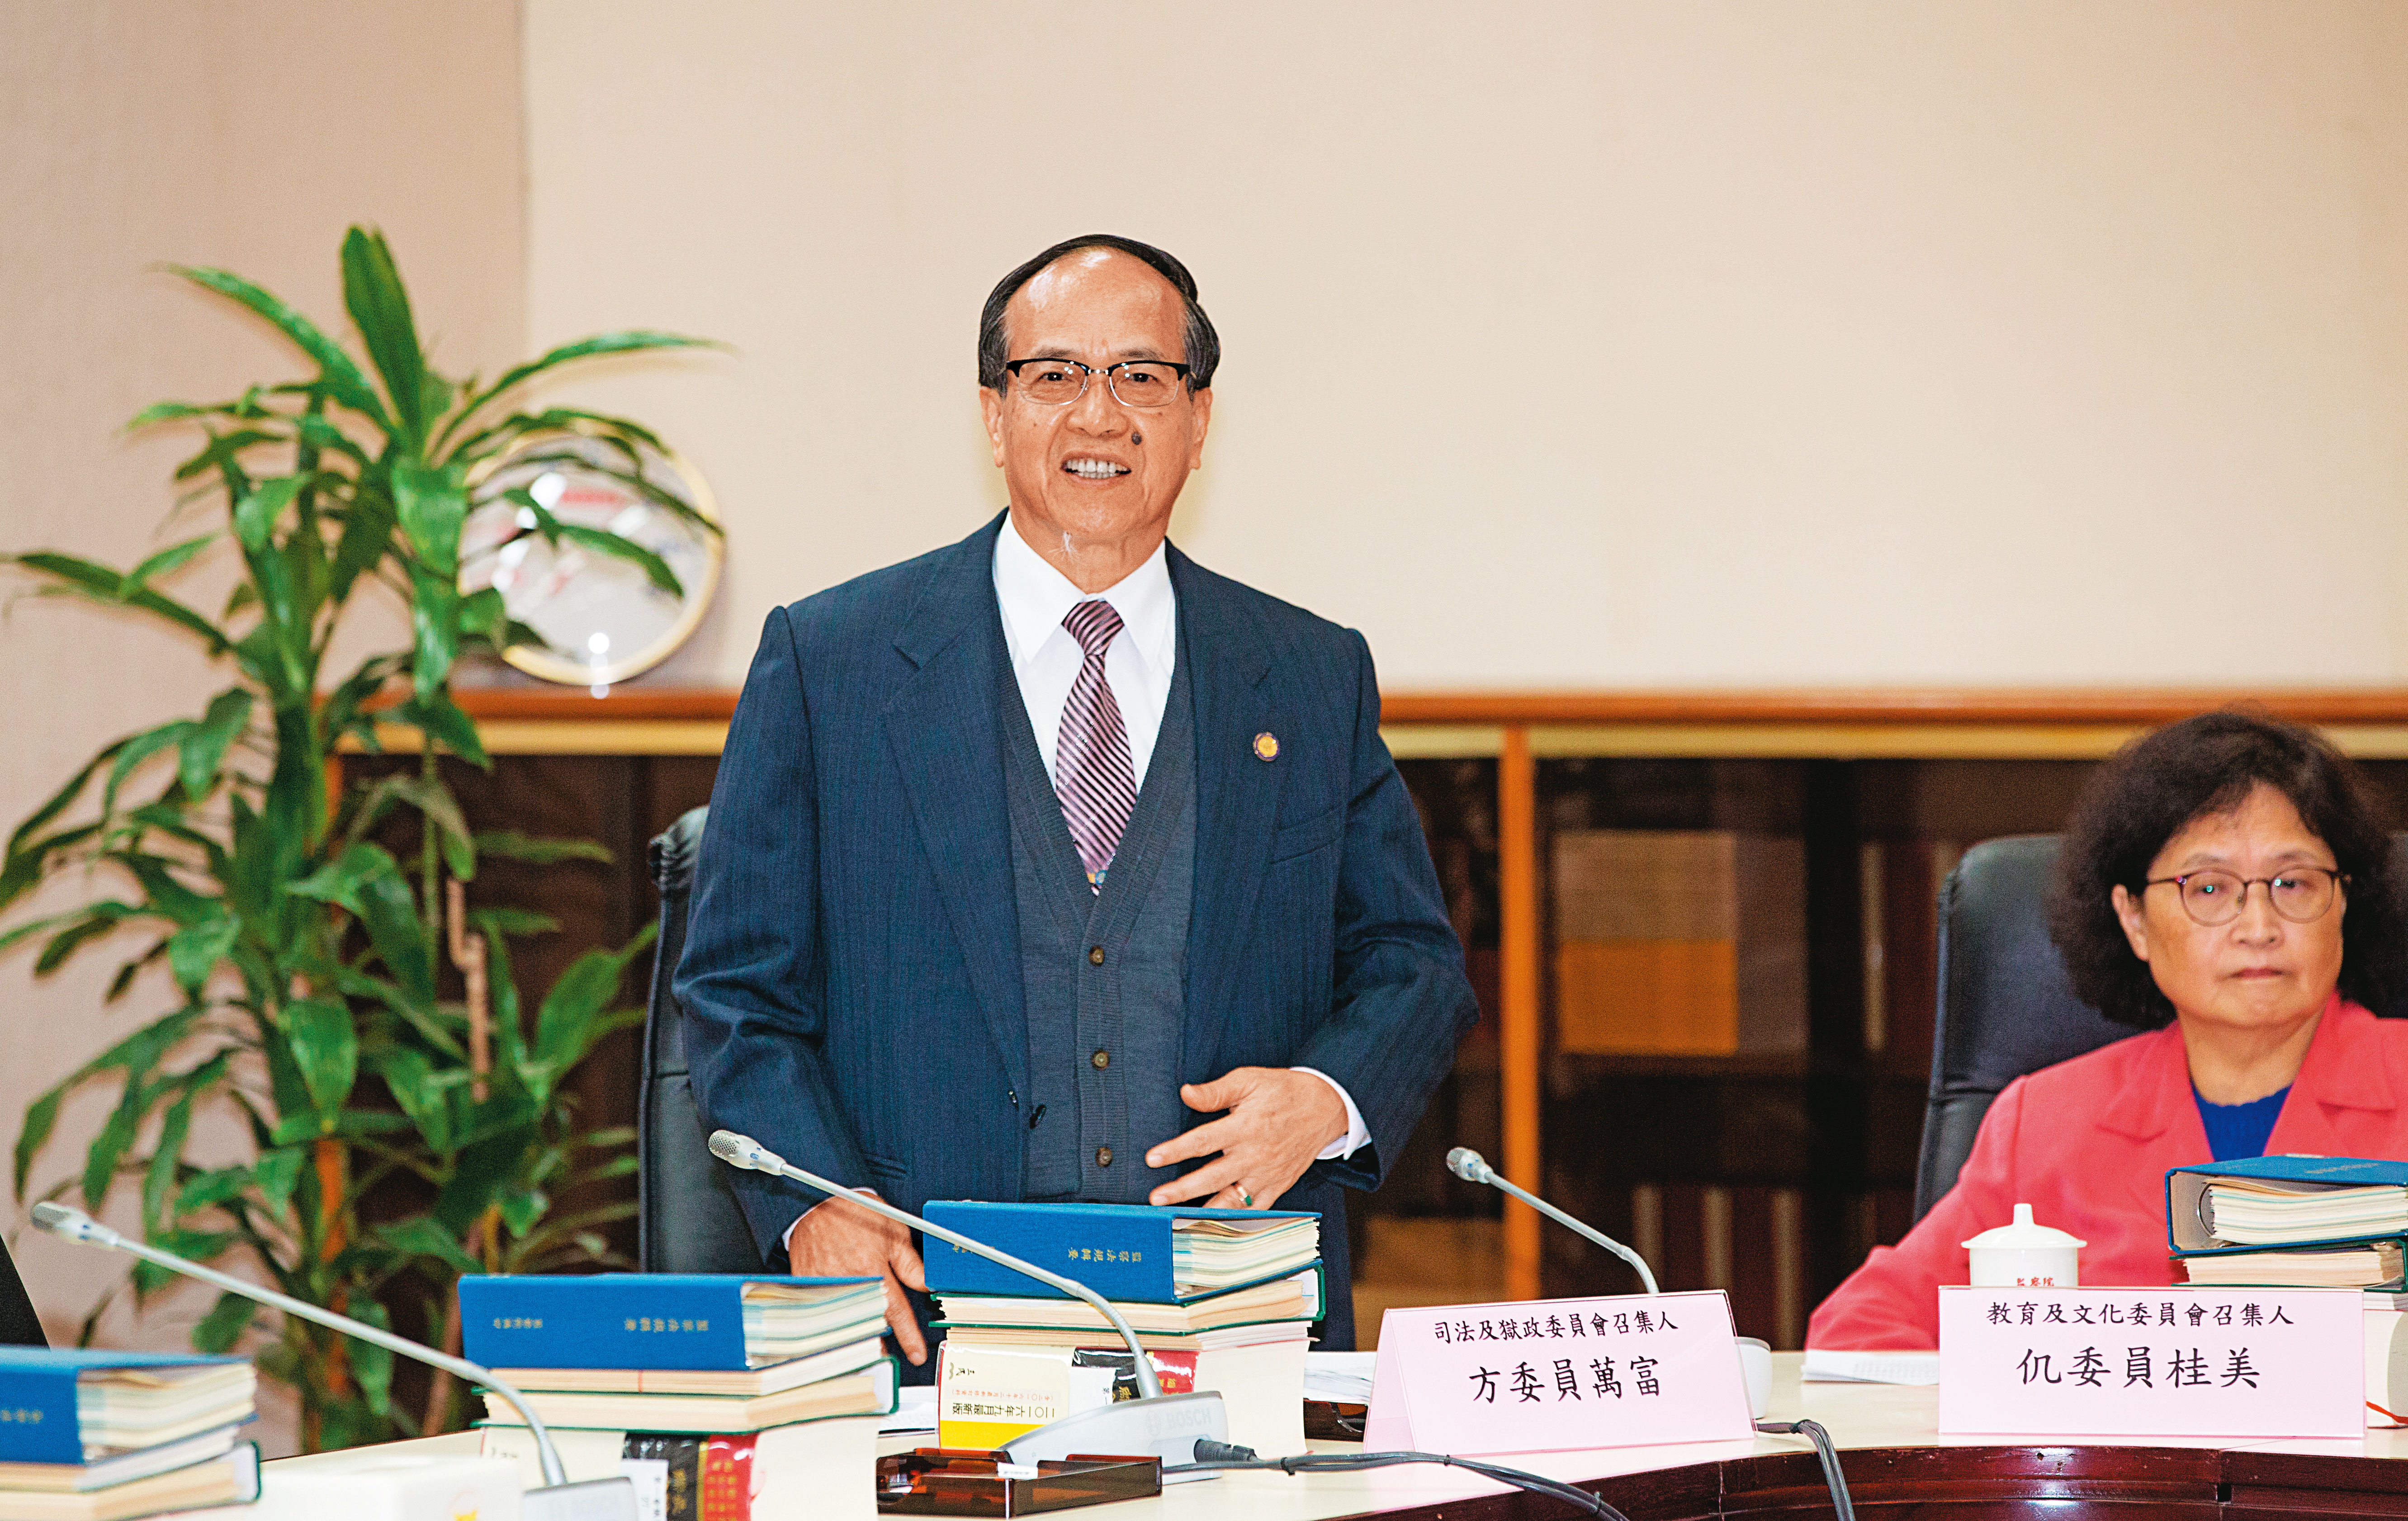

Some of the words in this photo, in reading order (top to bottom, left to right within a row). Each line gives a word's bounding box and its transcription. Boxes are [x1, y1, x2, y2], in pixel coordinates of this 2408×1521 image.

[1434, 1310, 1679, 1345] 司法及獄政委員會召集人
[1986, 1302, 2294, 1327] 教育及文化委員會召集人
[955, 1367, 975, 1376] 三民
[1469, 1355, 1660, 1404] 方委員萬富
[2015, 1346, 2261, 1389] 仉委員桂美
[1166, 1407, 1212, 1430] BOSCH
